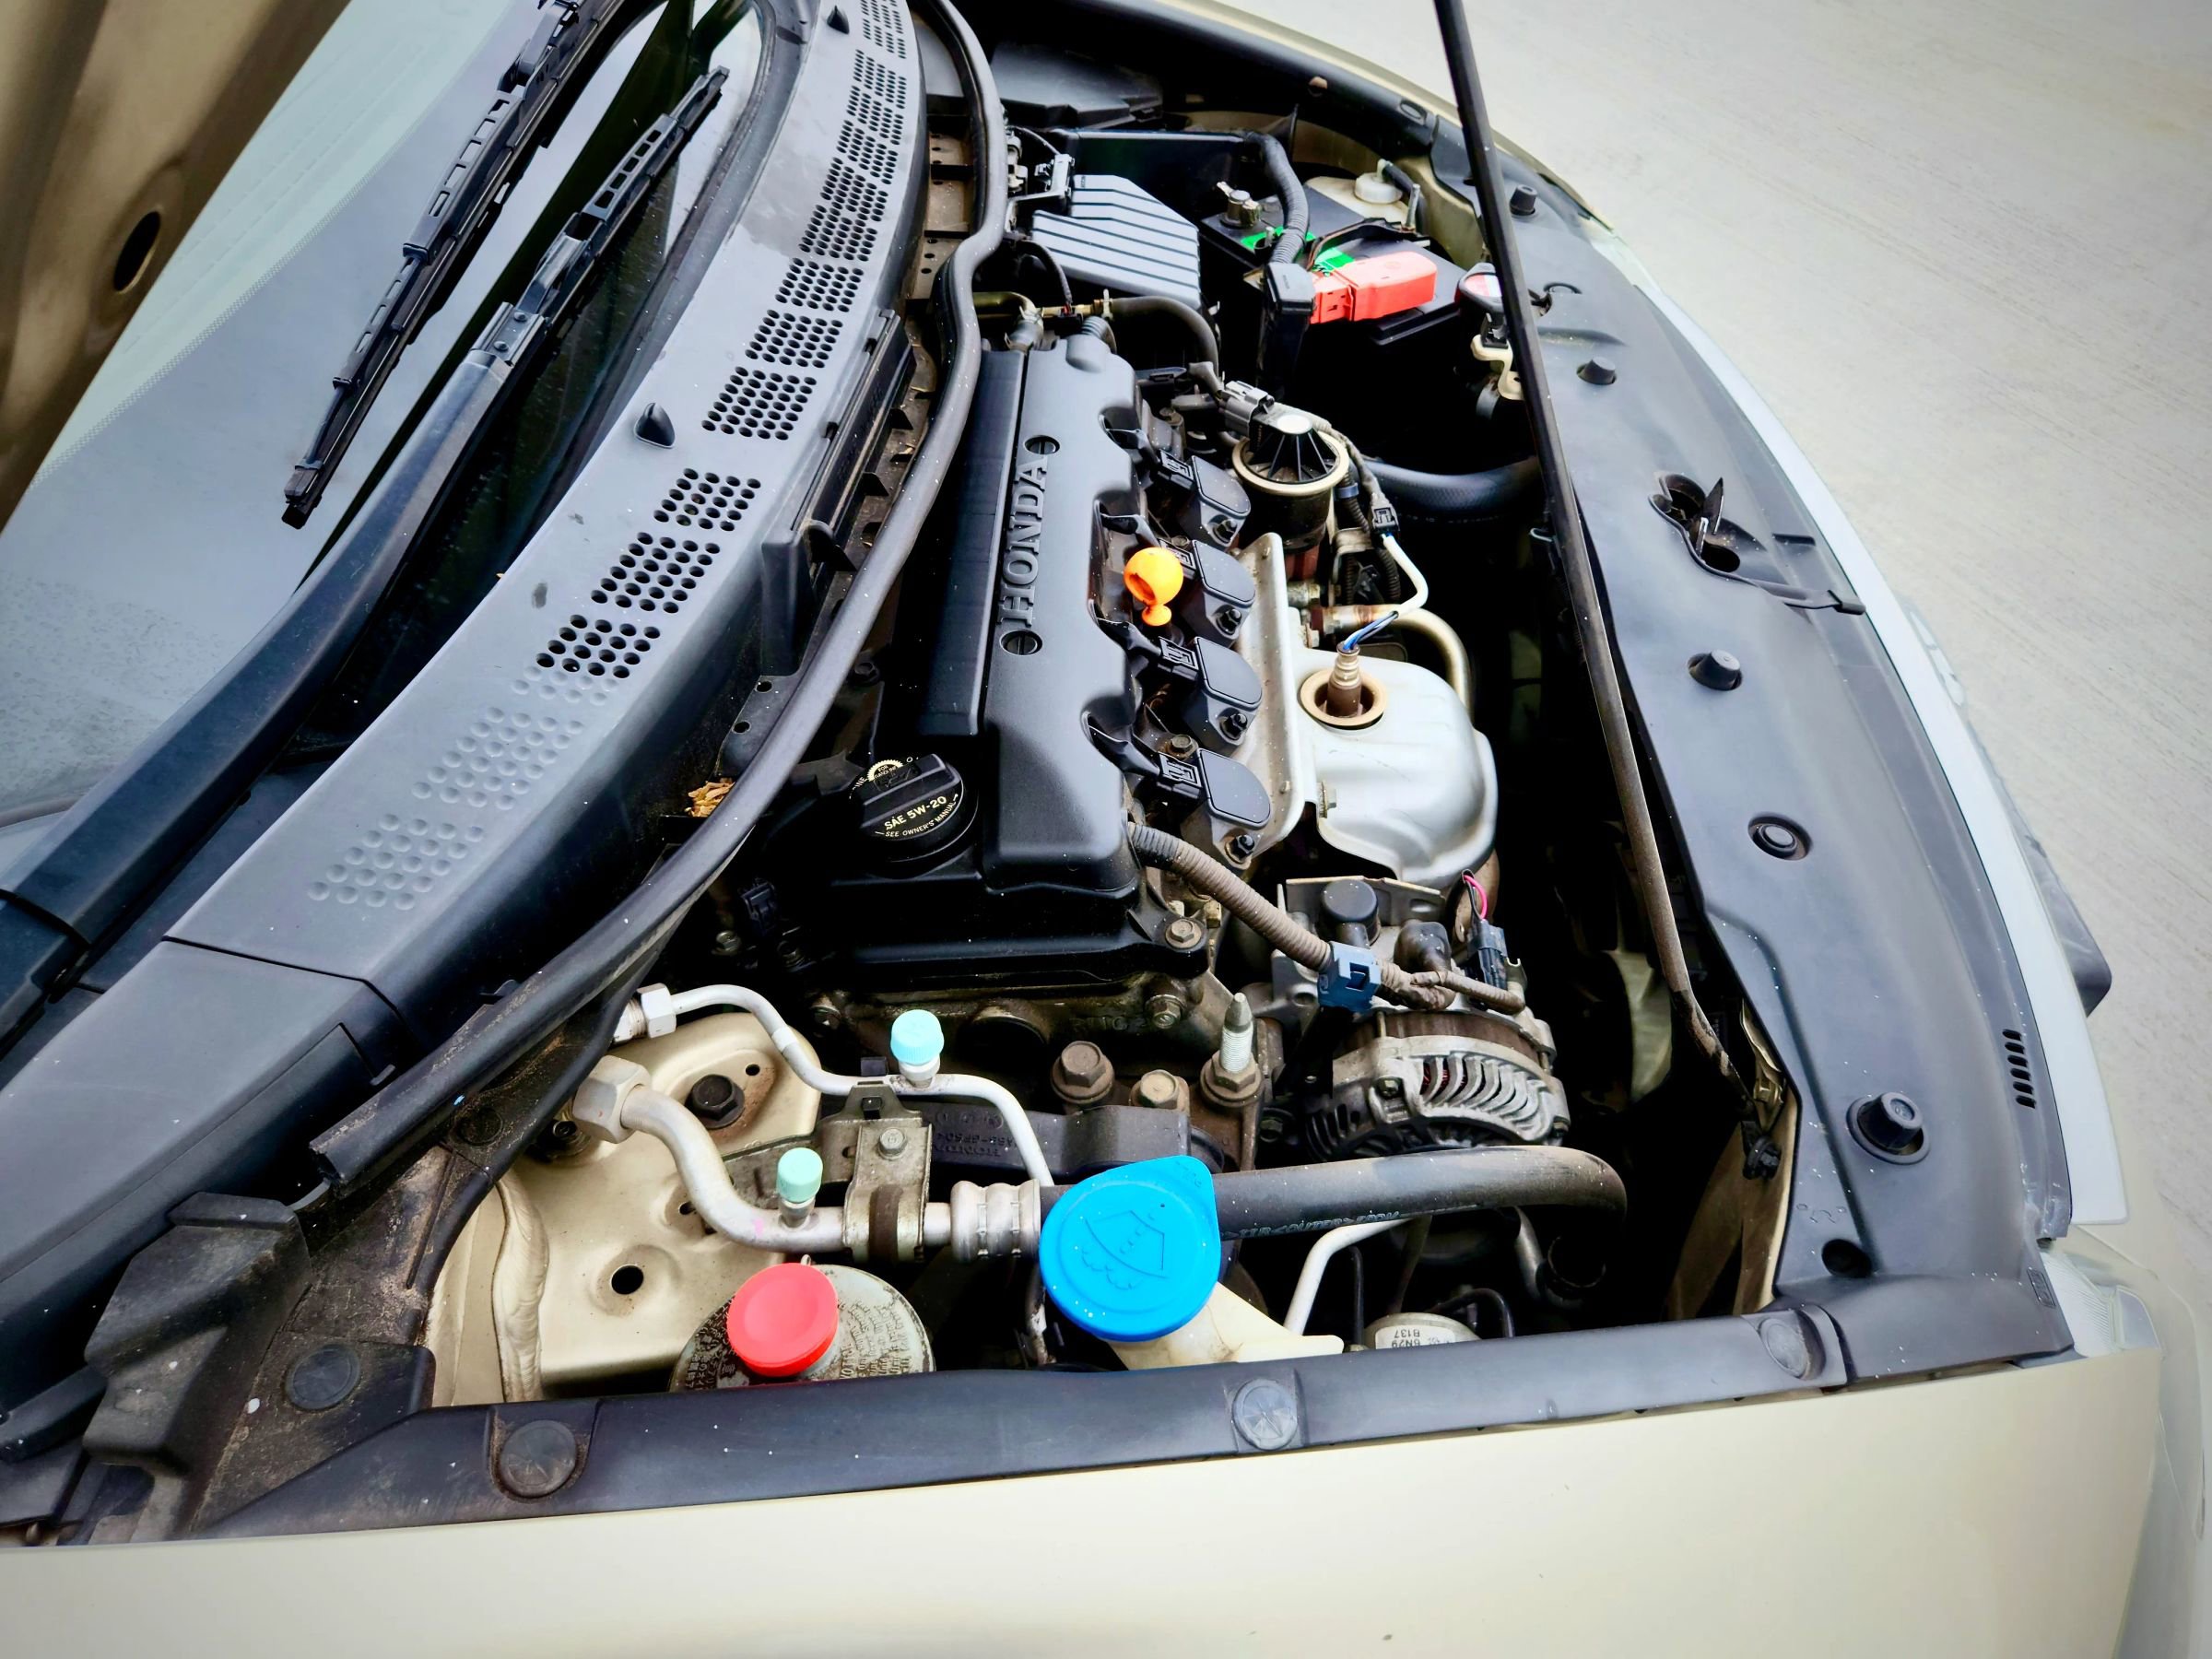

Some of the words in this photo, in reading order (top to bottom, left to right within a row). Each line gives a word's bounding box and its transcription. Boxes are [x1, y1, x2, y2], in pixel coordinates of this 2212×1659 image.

[996, 456, 1048, 627] HONDA
[884, 815, 907, 830] SAE
[907, 795, 947, 818] 5W-20
[902, 819, 935, 836] OWNER'S
[935, 800, 957, 823] MANUAL
[1394, 1328, 1420, 1337] B137
